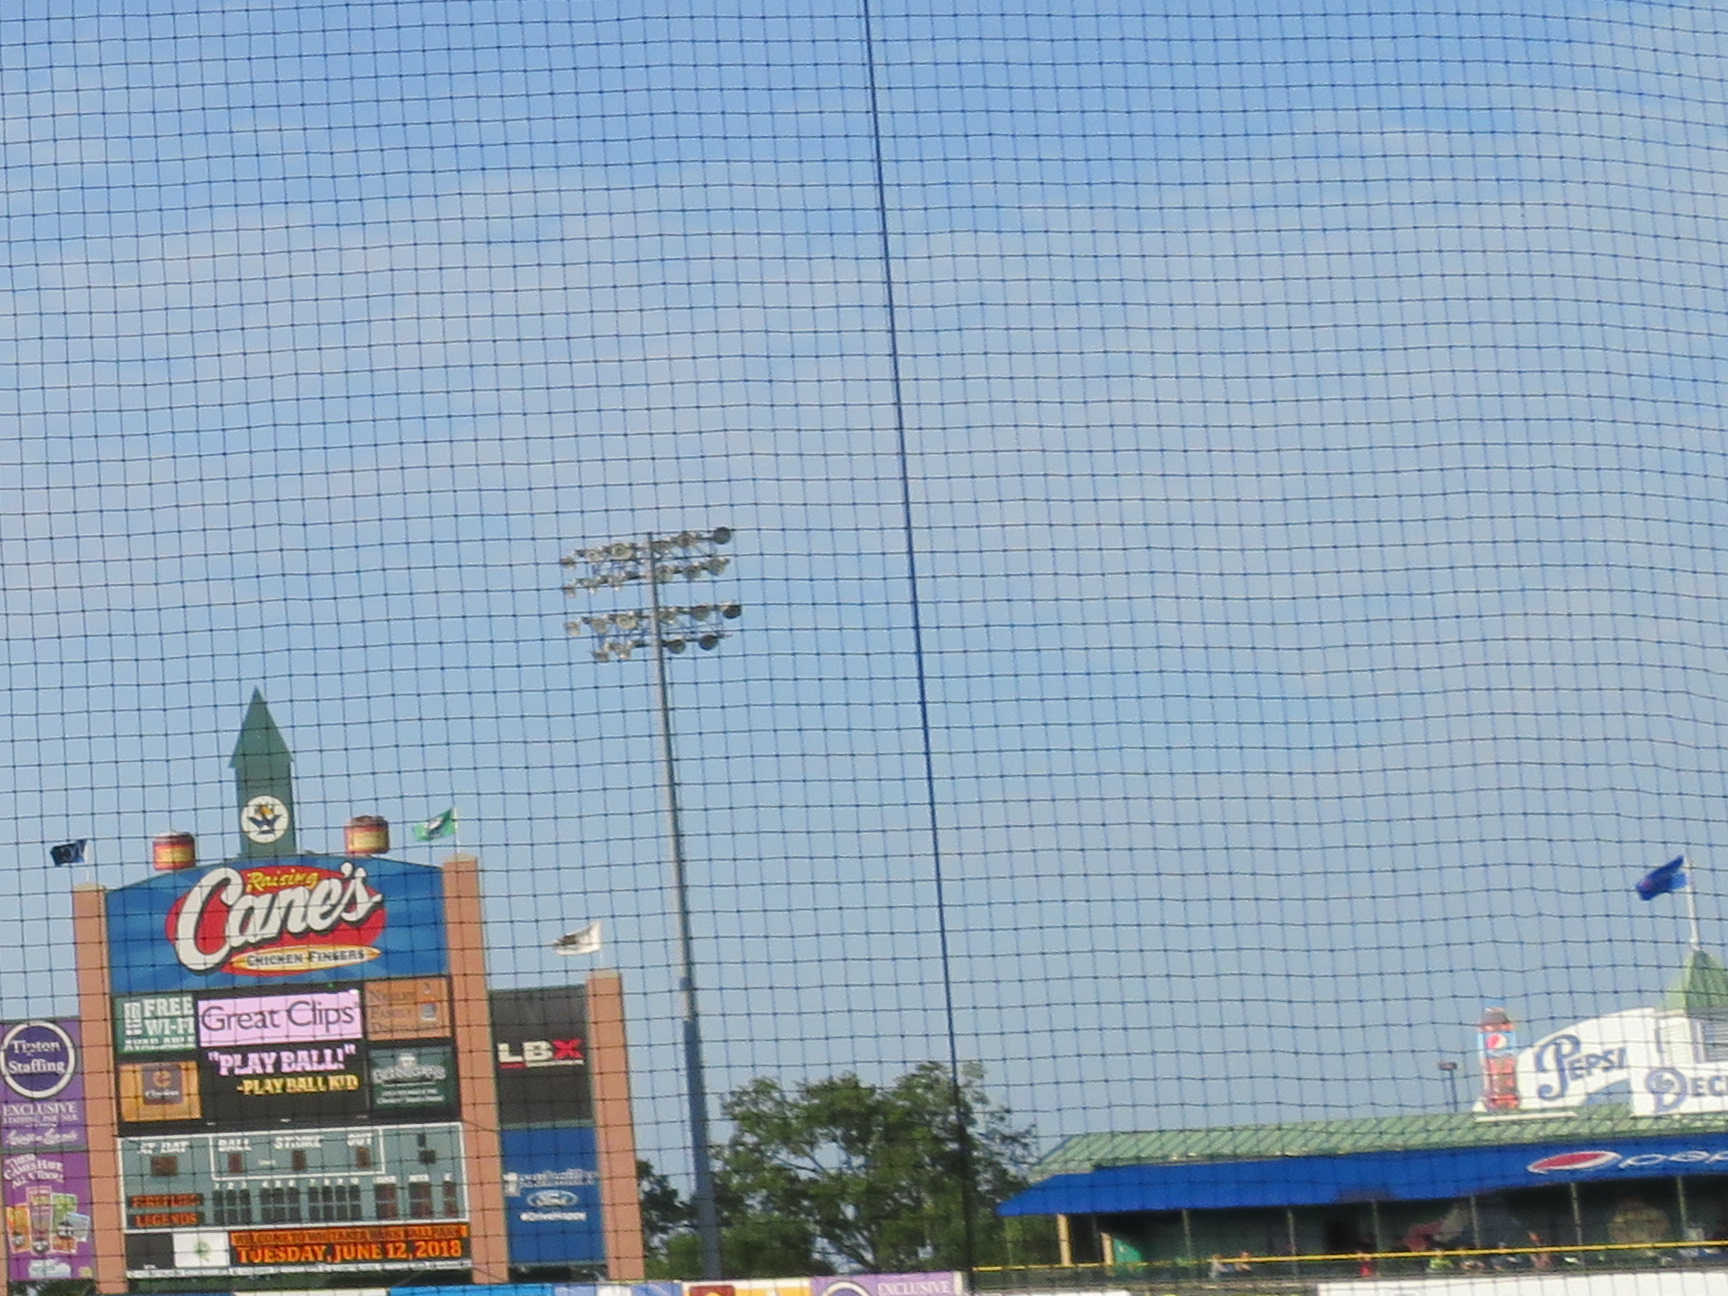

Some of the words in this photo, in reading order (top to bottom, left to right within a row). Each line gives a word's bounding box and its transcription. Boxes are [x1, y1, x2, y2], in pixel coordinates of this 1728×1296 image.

[245, 868, 320, 893] Raising
[175, 861, 383, 972] Cane's
[246, 954, 304, 967] CHICKEN
[307, 950, 366, 963] FINGERS
[145, 996, 195, 1018] FREE
[201, 1005, 283, 1032] Great
[286, 1000, 355, 1034] Clips
[145, 1018, 195, 1037] WI-FI
[11, 1039, 61, 1057] Tipton
[497, 1038, 584, 1064] LBX
[8, 1058, 66, 1075] Staffing
[286, 1076, 326, 1093] BALL
[1644, 1067, 1728, 1115] DEC
[3, 1101, 78, 1116] EXCLUSIVE
[218, 1138, 252, 1152] BALL
[134, 1212, 200, 1228] LEGENDS
[237, 1245, 332, 1264] TUESDAY,
[332, 1243, 382, 1263] JUNE
[386, 1241, 413, 1261] 12,
[416, 1240, 462, 1258] 2018
[877, 1280, 953, 1296] EXCLUSIVE
